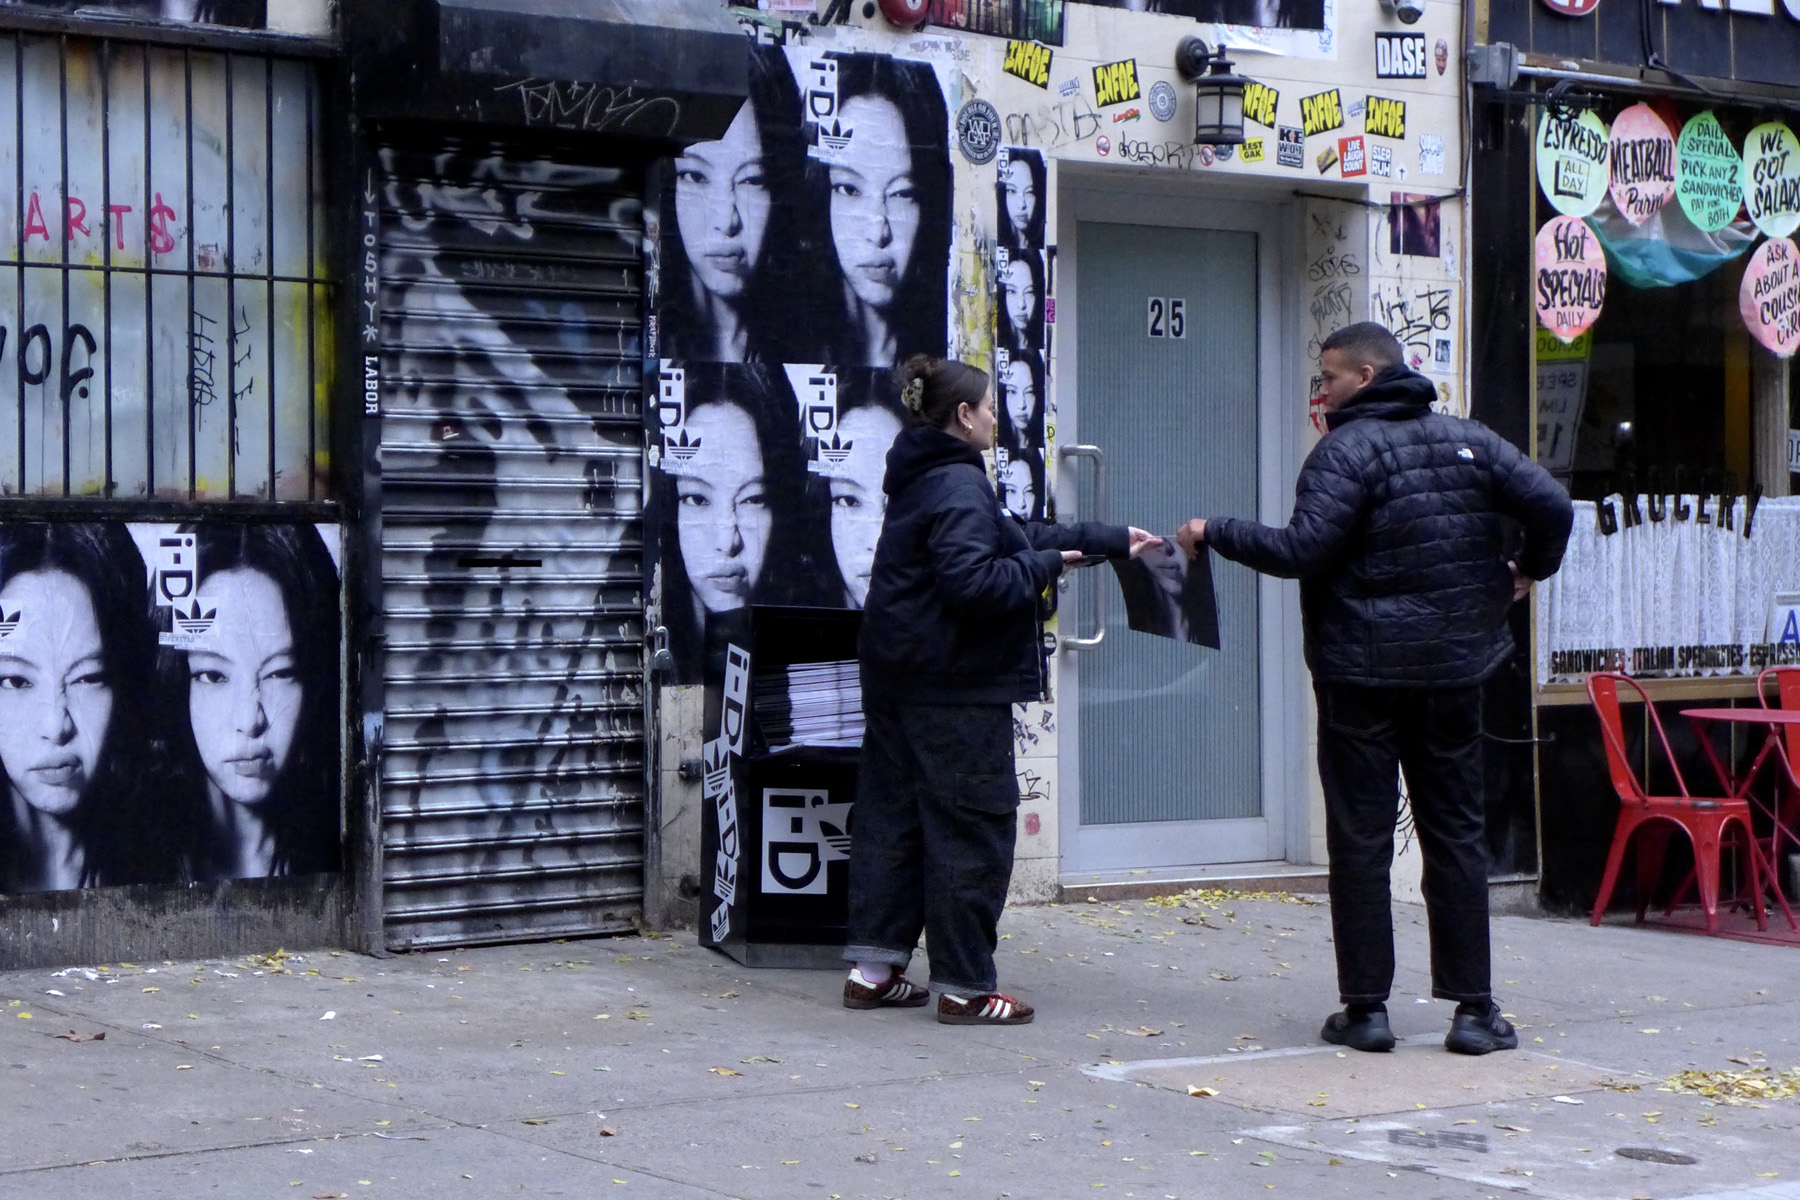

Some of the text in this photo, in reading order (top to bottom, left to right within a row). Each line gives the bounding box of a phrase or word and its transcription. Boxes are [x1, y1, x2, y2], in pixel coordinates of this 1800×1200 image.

[1004, 41, 1051, 84] INFOE
[1376, 36, 1426, 76] DASE
[1095, 61, 1139, 107] INFOE
[1302, 90, 1342, 136] INFOE
[1366, 96, 1405, 137] INFOE
[1697, 122, 1725, 140] DAILY
[1543, 117, 1608, 165] ESPRESSO
[1687, 137, 1736, 158] SPECIALS
[1760, 128, 1785, 155] WE
[1564, 160, 1583, 175] ALL
[1609, 137, 1675, 187] MEATBALL
[1681, 158, 1739, 184] PICK ANY 2
[1753, 151, 1790, 186] GOT
[1562, 175, 1584, 191] DAY
[1680, 180, 1743, 203] SANDWICHES
[1752, 176, 1800, 218] SALADS
[1691, 197, 1706, 213] PAY
[1708, 206, 1730, 226] BOTH
[1554, 221, 1590, 262] Hot
[1767, 243, 1789, 267] ASK
[1538, 267, 1606, 311] SPECIALS
[1753, 258, 1799, 299] ABOUT A
[1150, 298, 1184, 337] 25
[1556, 311, 1585, 328] DAILY
[365, 355, 379, 415] LABOR
[1595, 464, 1763, 539] GROCERY
[1780, 609, 1800, 650] A
[1551, 648, 1626, 674] SANDWICHES
[1632, 646, 1675, 672] ITALIAN
[1678, 644, 1744, 669] SPECIALTIES
